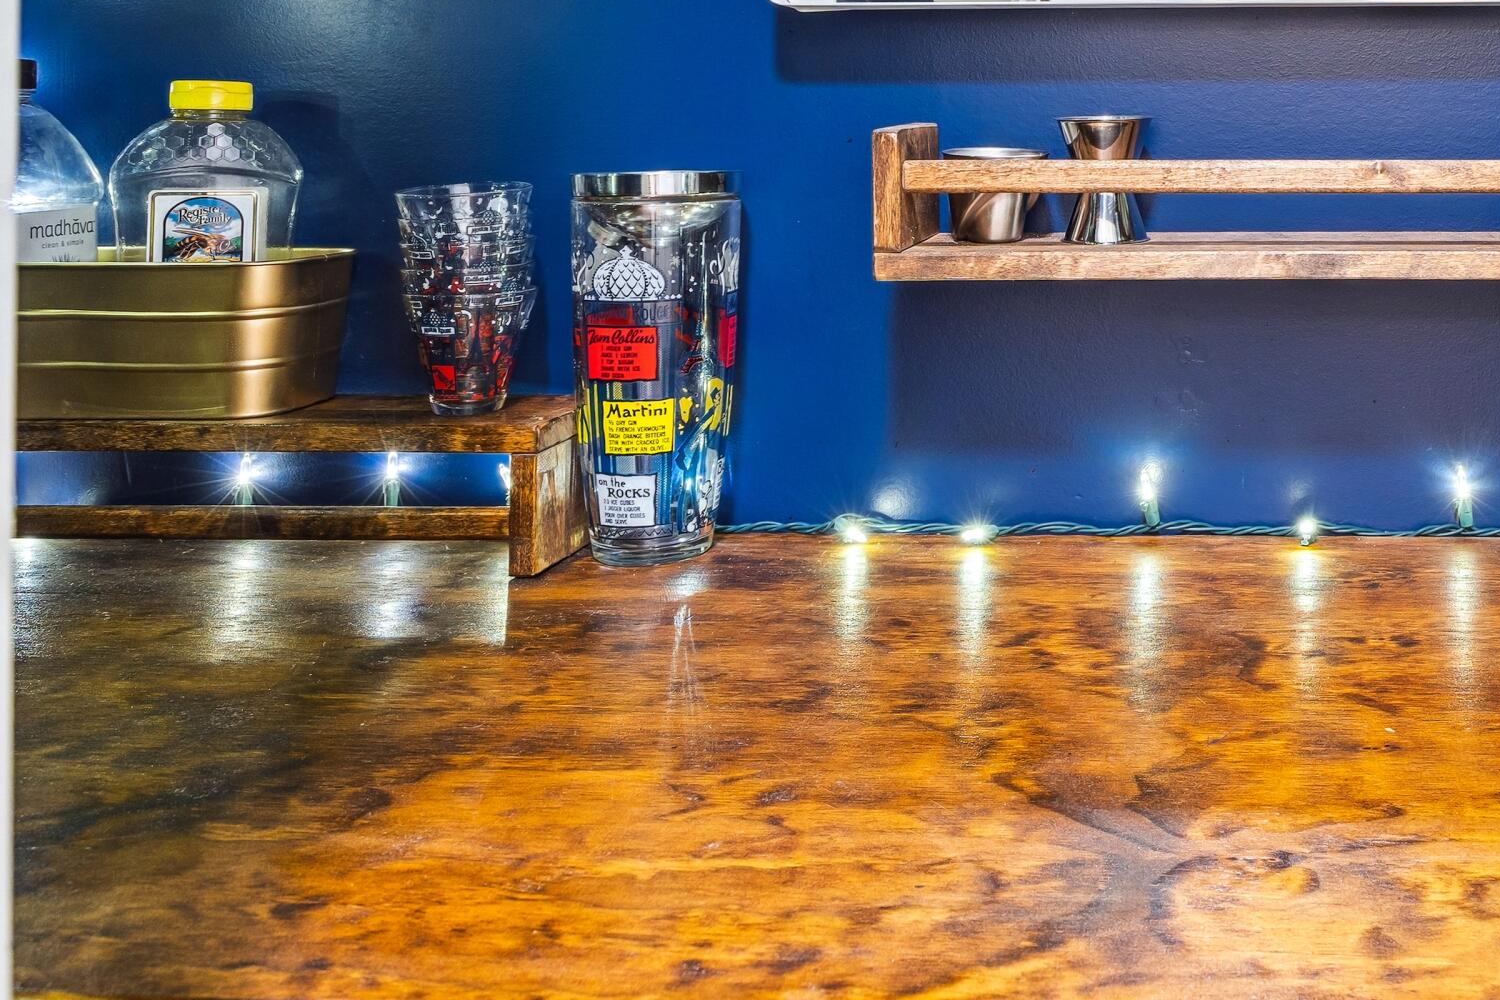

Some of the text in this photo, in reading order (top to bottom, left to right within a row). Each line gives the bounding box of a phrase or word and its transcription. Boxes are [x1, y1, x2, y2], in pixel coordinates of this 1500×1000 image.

[176, 205, 222, 225] Register
[197, 214, 233, 226] Family
[41, 240, 60, 249] clean
[588, 328, 655, 345] Tom Collins
[606, 402, 668, 419] Martini
[610, 477, 626, 487] the
[607, 487, 651, 499] ROCKS
